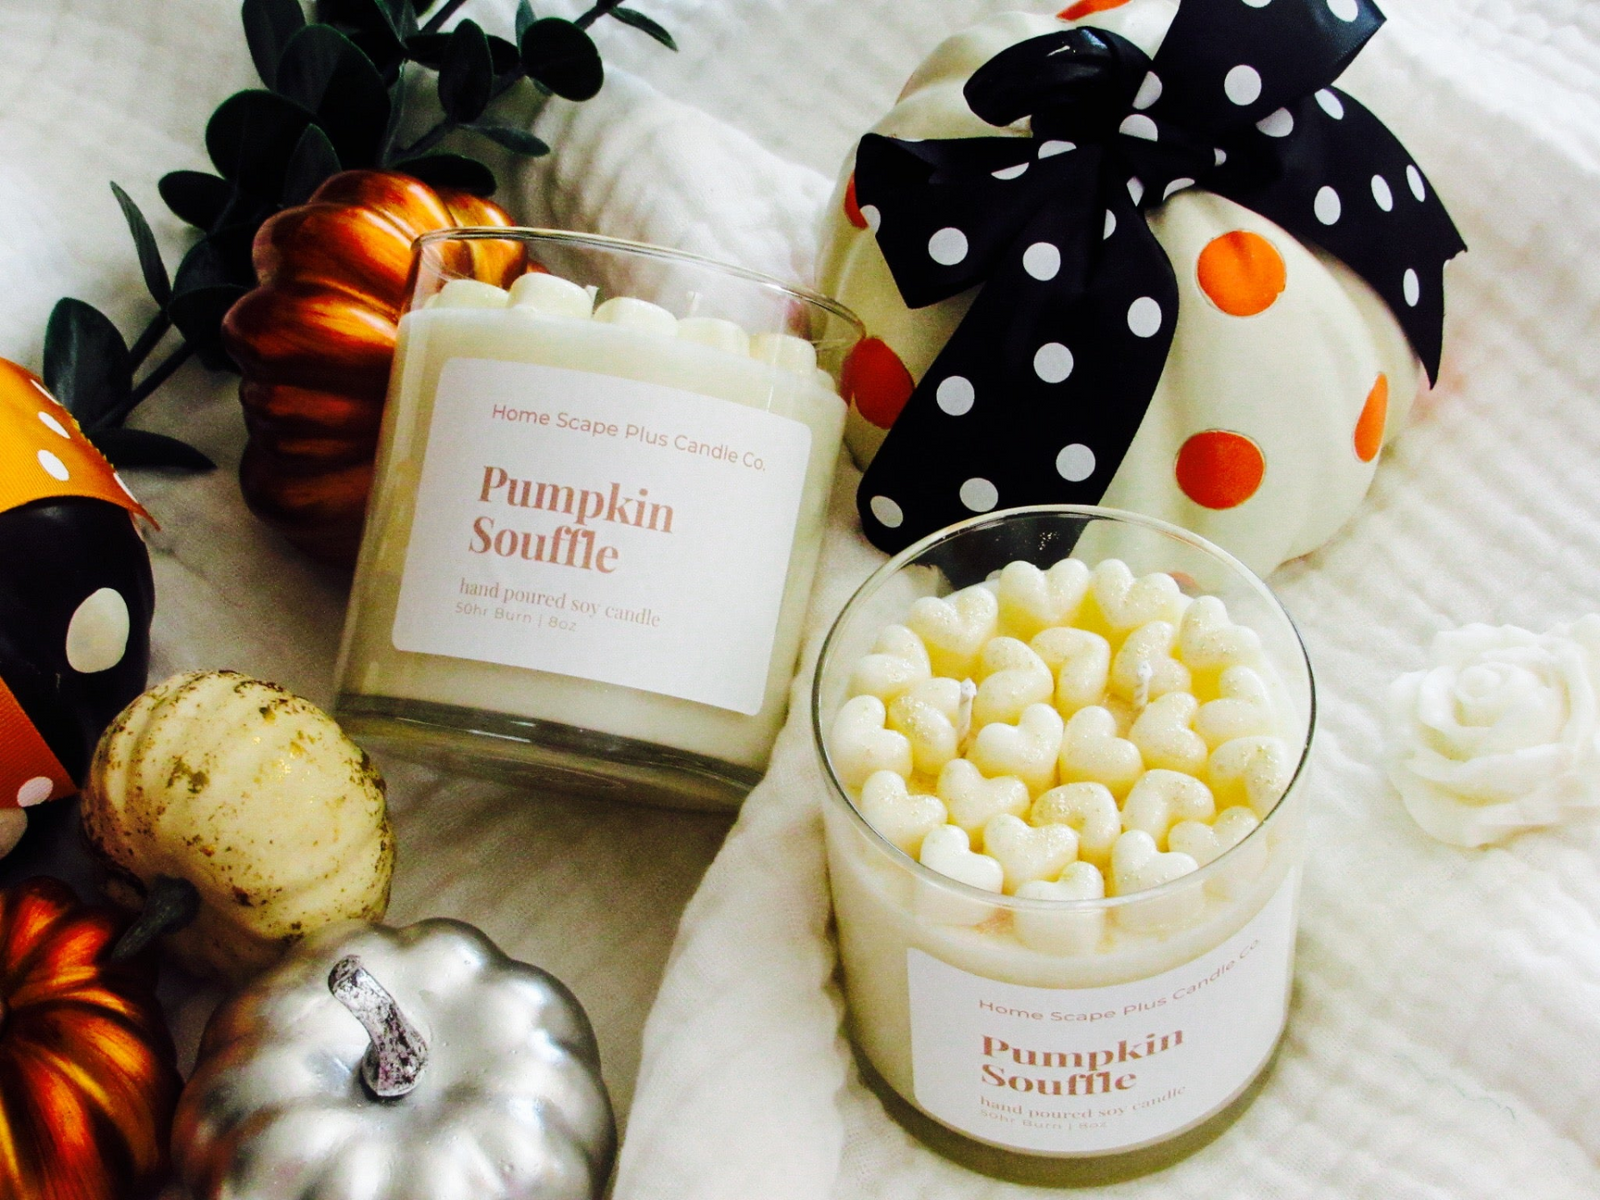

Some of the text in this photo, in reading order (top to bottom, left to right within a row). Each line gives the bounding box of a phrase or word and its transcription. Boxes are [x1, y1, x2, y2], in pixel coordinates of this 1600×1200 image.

[492, 404, 766, 472] Home Scape Plus Candle Co.
[478, 465, 675, 534] Pumpkin
[468, 515, 619, 574] Souffle
[455, 601, 488, 616] 50hr
[494, 607, 532, 624] Burn
[548, 616, 577, 632] 8oz
[459, 577, 661, 628] hand poured soy candle
[978, 999, 1044, 1021] Home
[1050, 1010, 1117, 1024] Scape
[1123, 997, 1168, 1017] Plus
[1172, 960, 1235, 1000] Candle
[980, 1028, 1184, 1071] Pumpkin
[980, 1063, 1138, 1096] Souffle
[980, 1086, 1186, 1119] hand poured soy candle
